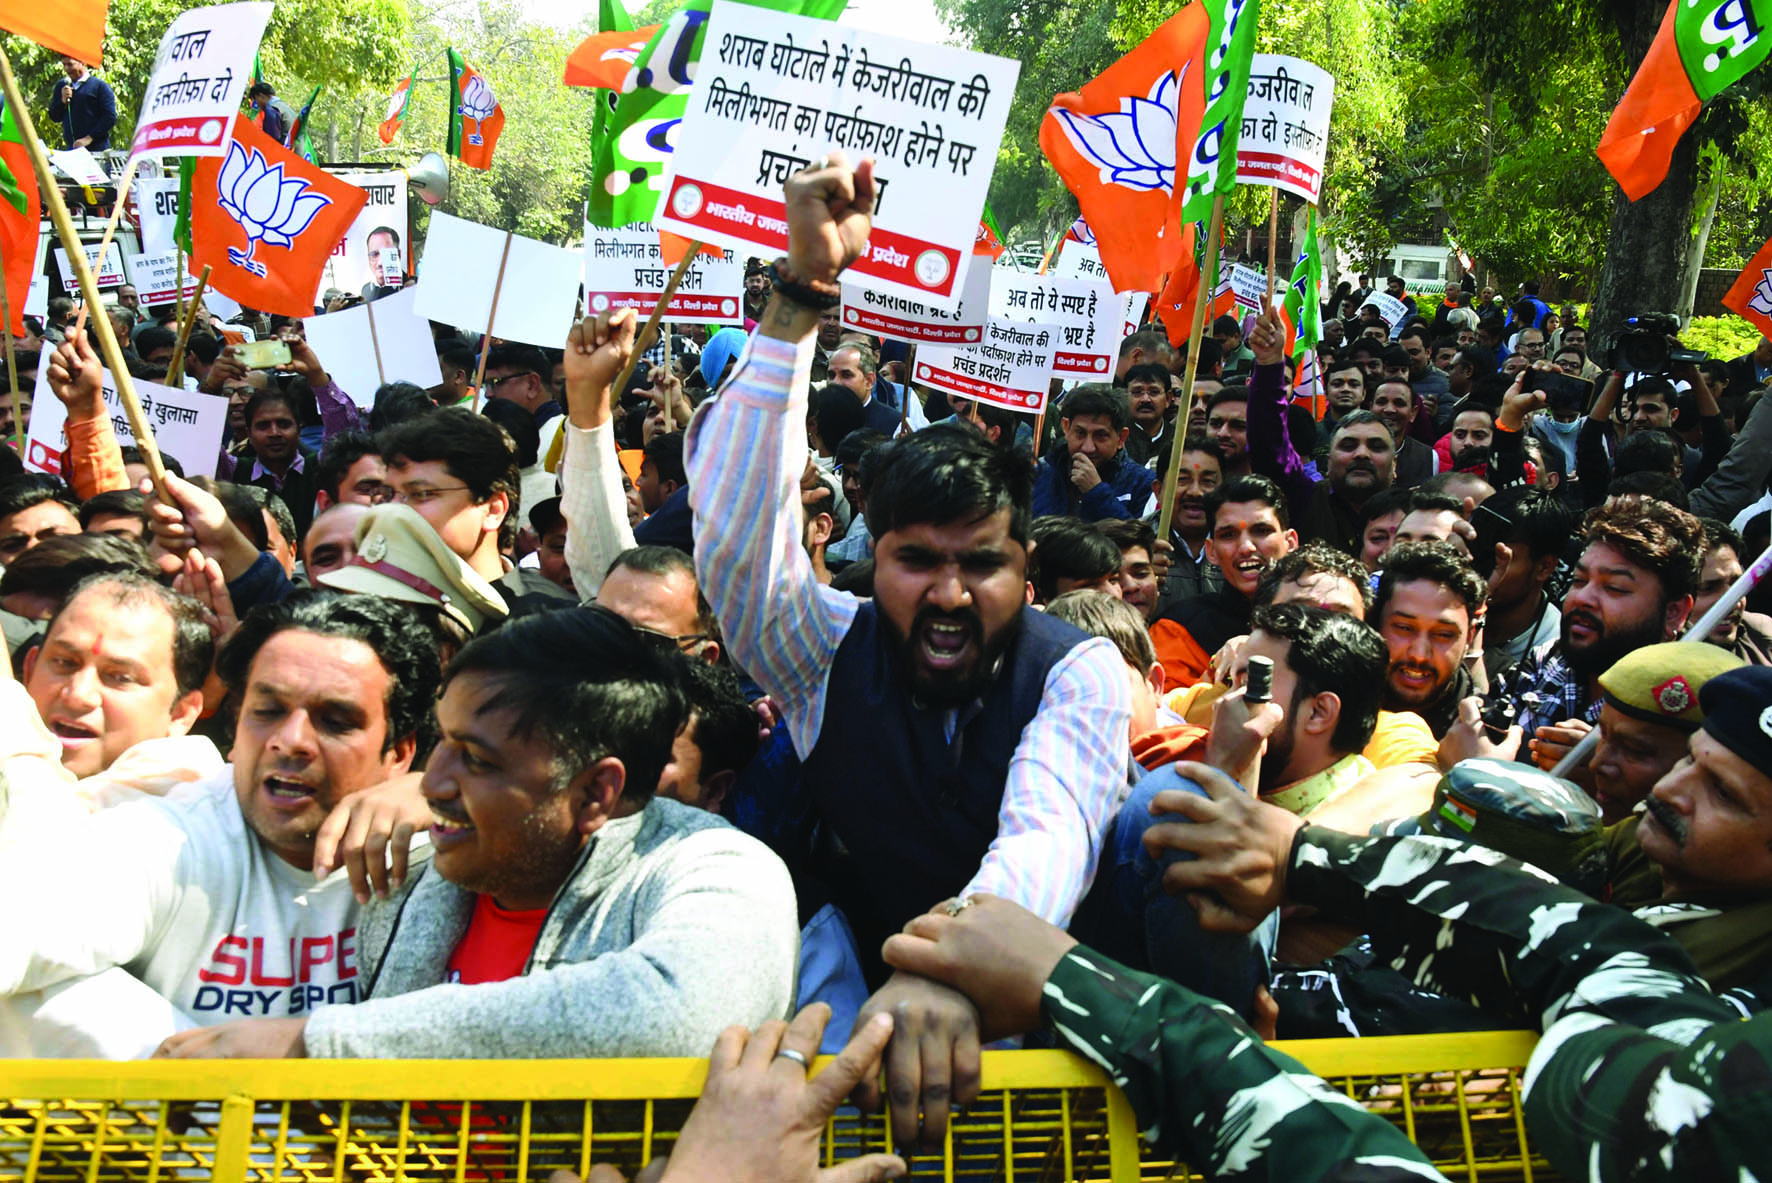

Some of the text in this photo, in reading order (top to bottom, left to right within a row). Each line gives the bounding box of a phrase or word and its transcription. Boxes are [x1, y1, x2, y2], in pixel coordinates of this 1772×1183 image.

[211, 67, 233, 104] दो
[719, 33, 991, 121] शराब घोटाले में केजरीवाल की
[704, 77, 977, 176] मिलीभगत का पर्दाफ़ाश होने पर
[1262, 111, 1278, 143] दो
[705, 200, 789, 236] भारतीय जनत
[594, 238, 645, 260] मिलीभगत
[872, 245, 910, 269] प्रदेश
[634, 263, 665, 289] प्रचंड
[1078, 257, 1095, 274] अब
[1007, 286, 1098, 319] अब तो ये स्पष्ट है
[990, 321, 1049, 348] केजरीवाल की
[1064, 321, 1096, 349] भ्रष्ट है
[952, 354, 1011, 384] प्रचंड प्रदर्शन
[1016, 349, 1033, 367] होने
[1035, 355, 1046, 368] पर
[155, 402, 199, 426] खुलासा
[198, 927, 358, 987] SUPE
[192, 981, 363, 1016] DRY SPO
